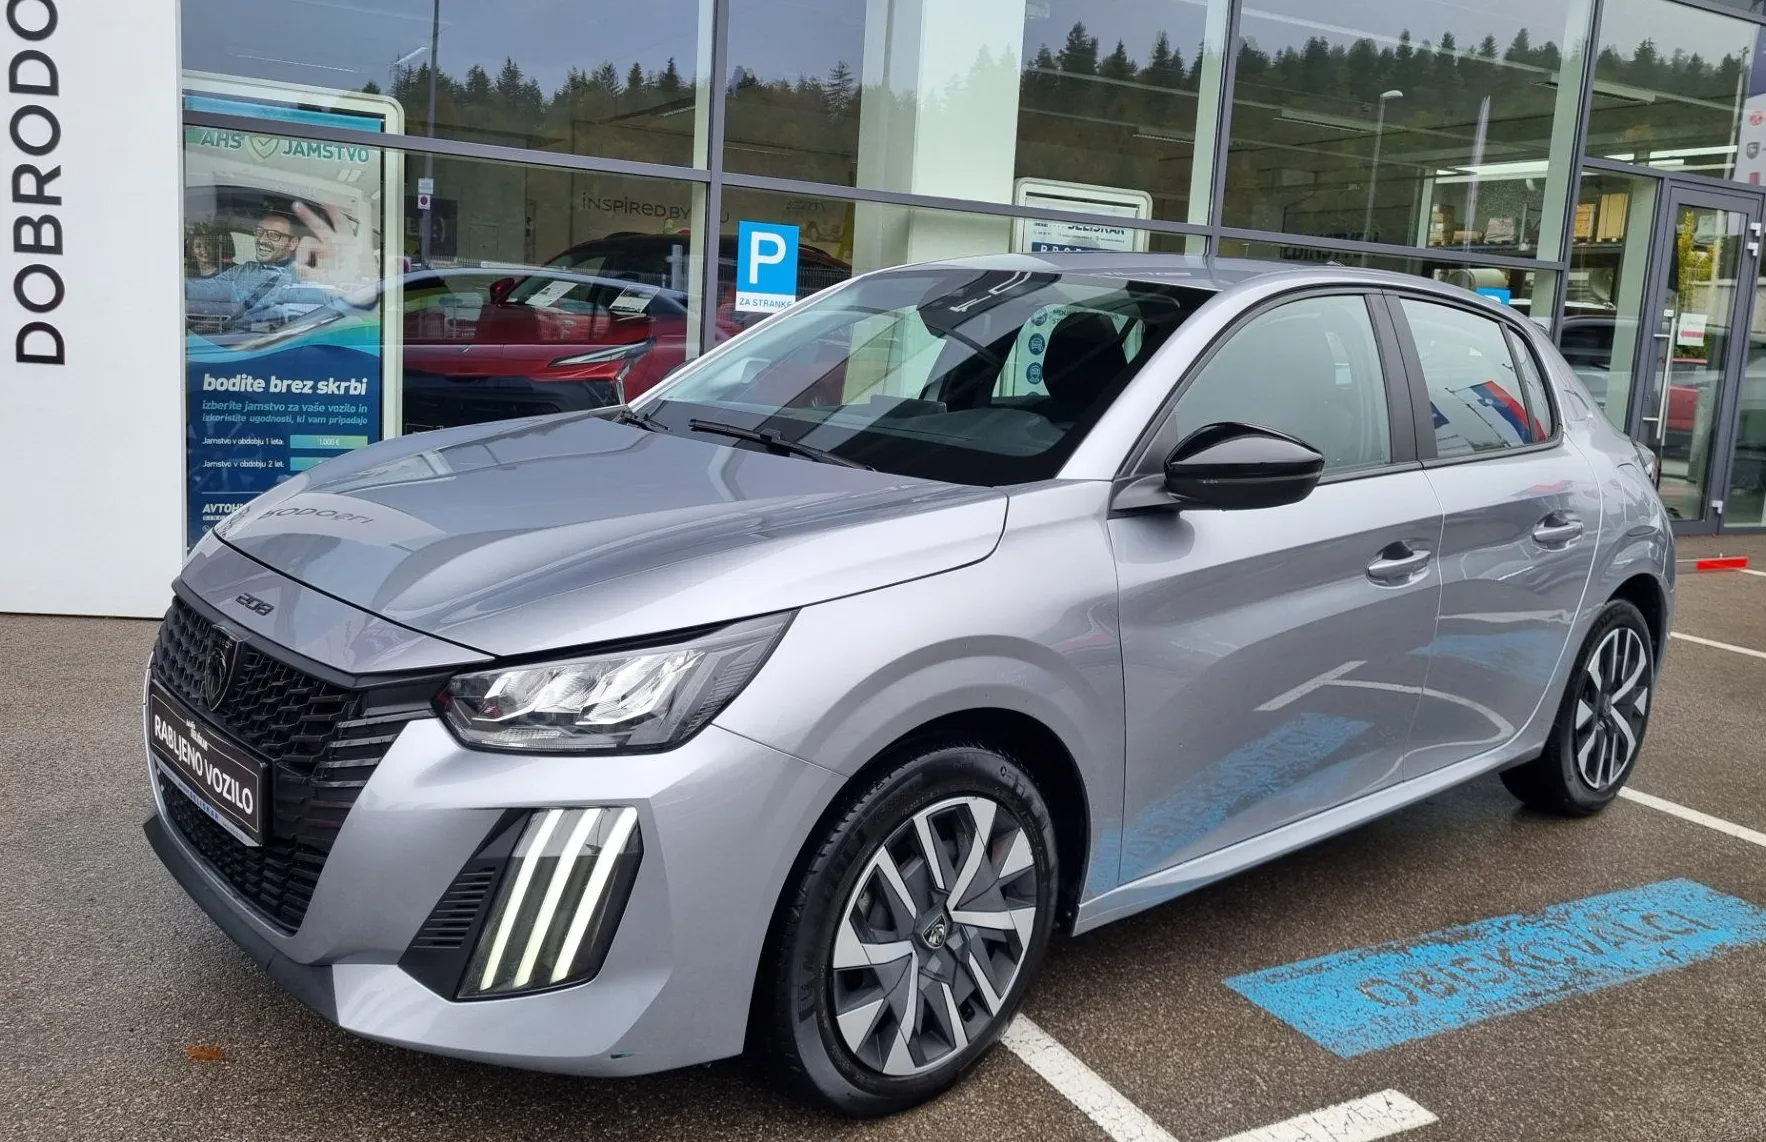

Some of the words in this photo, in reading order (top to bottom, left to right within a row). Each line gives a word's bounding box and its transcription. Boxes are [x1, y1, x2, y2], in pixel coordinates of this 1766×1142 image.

[200, 131, 242, 150] AHS
[282, 140, 370, 163] JAMSTVO
[6, 0, 66, 366] DOBRODO
[749, 231, 787, 284] P
[739, 297, 750, 306] ZA
[752, 298, 793, 309] STRANKE
[203, 373, 266, 392] bodite
[269, 375, 314, 394] brez
[316, 377, 368, 396] skrbi
[202, 400, 242, 411] izberite
[243, 401, 286, 413] jamstvo
[287, 404, 299, 412] za
[302, 402, 325, 413] vaše
[327, 402, 356, 413] vozilo
[358, 403, 368, 414] in
[249, 414, 294, 424] ugodnosti,
[296, 414, 305, 423] ki
[308, 416, 326, 424] vam
[328, 416, 368, 426] pripadajo
[202, 437, 231, 445] Jamstvo
[237, 437, 264, 446] obdobju
[202, 460, 232, 468] Jamstvo
[239, 460, 266, 469] obdobju
[268, 460, 273, 468] 2
[202, 503, 243, 514] AVTOH
[235, 592, 275, 616] 208
[154, 714, 203, 776] RABLJENO
[204, 758, 253, 815] VOZILO
